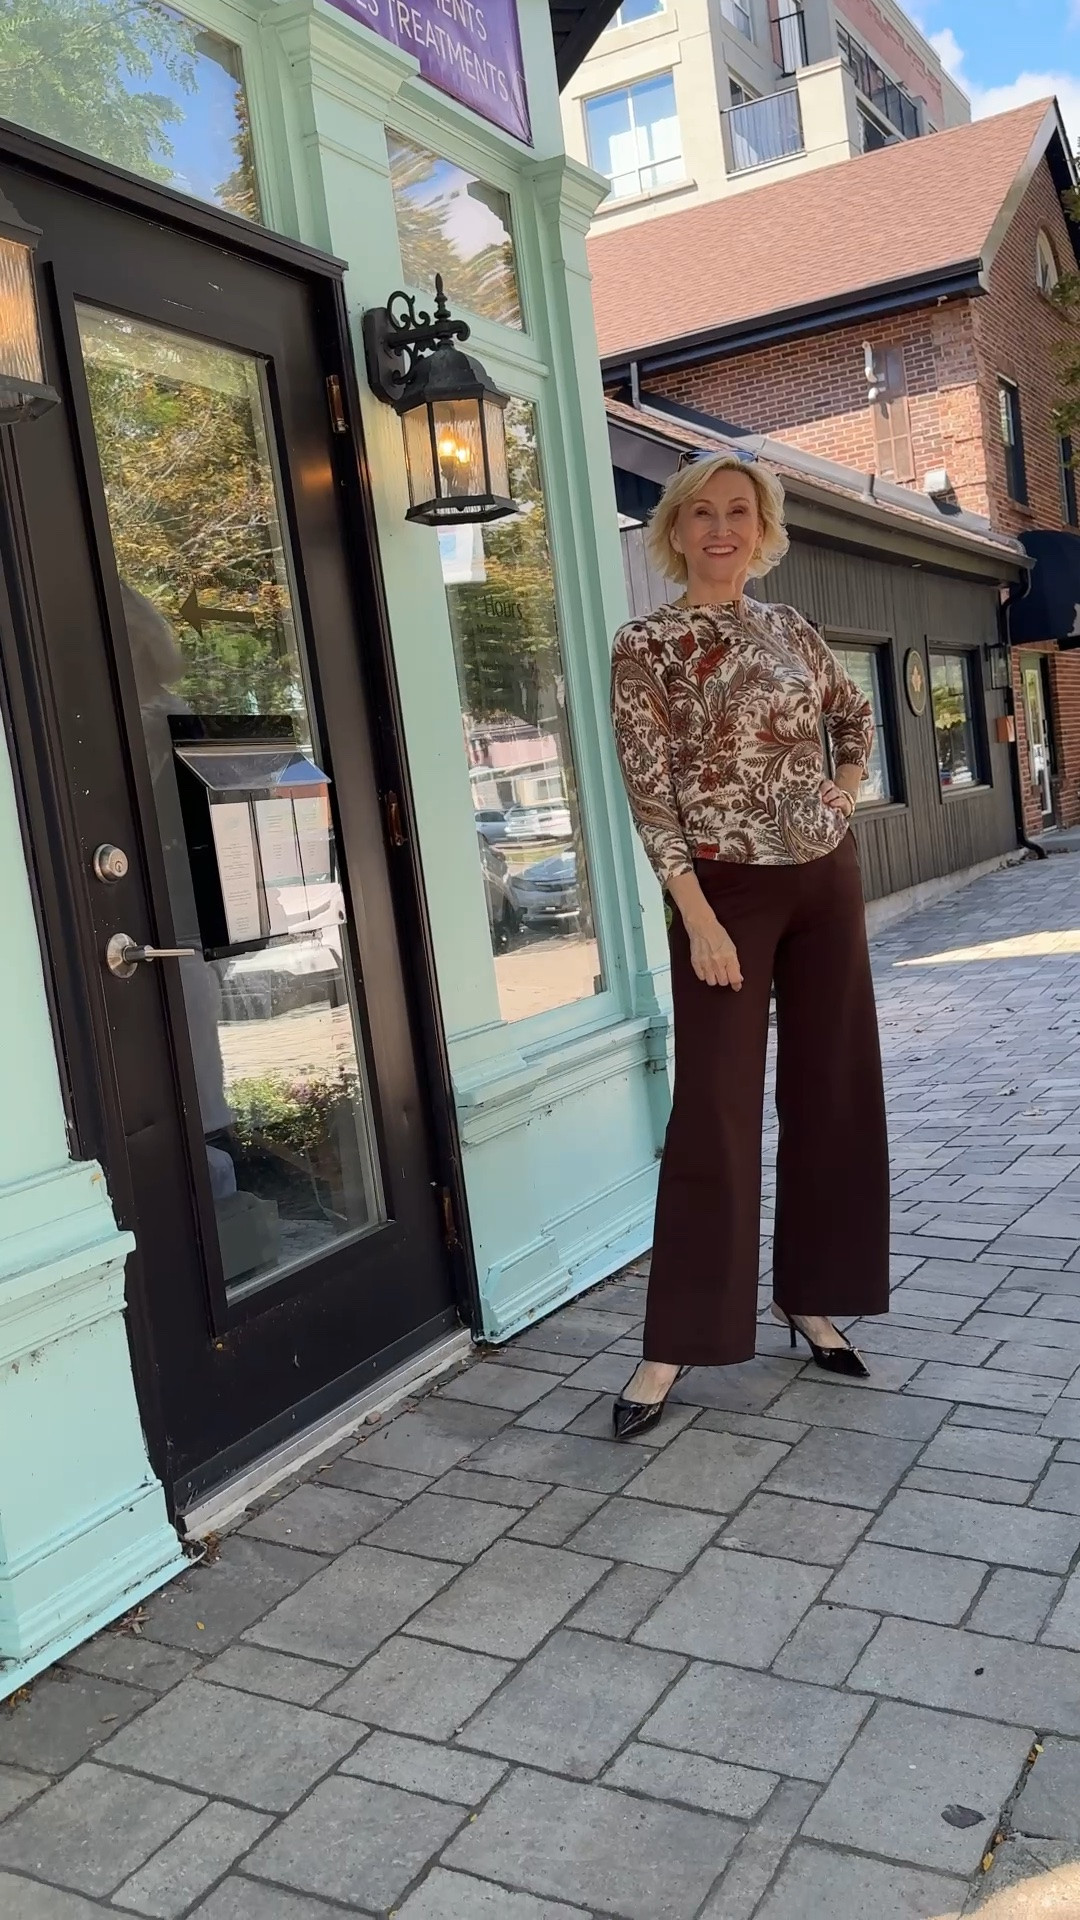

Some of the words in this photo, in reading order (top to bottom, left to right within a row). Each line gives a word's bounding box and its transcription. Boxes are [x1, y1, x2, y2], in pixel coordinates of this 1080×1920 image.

[436, 0, 487, 41] ENTS
[387, 0, 509, 102] TREATMENTS
[484, 595, 523, 620] Hours
